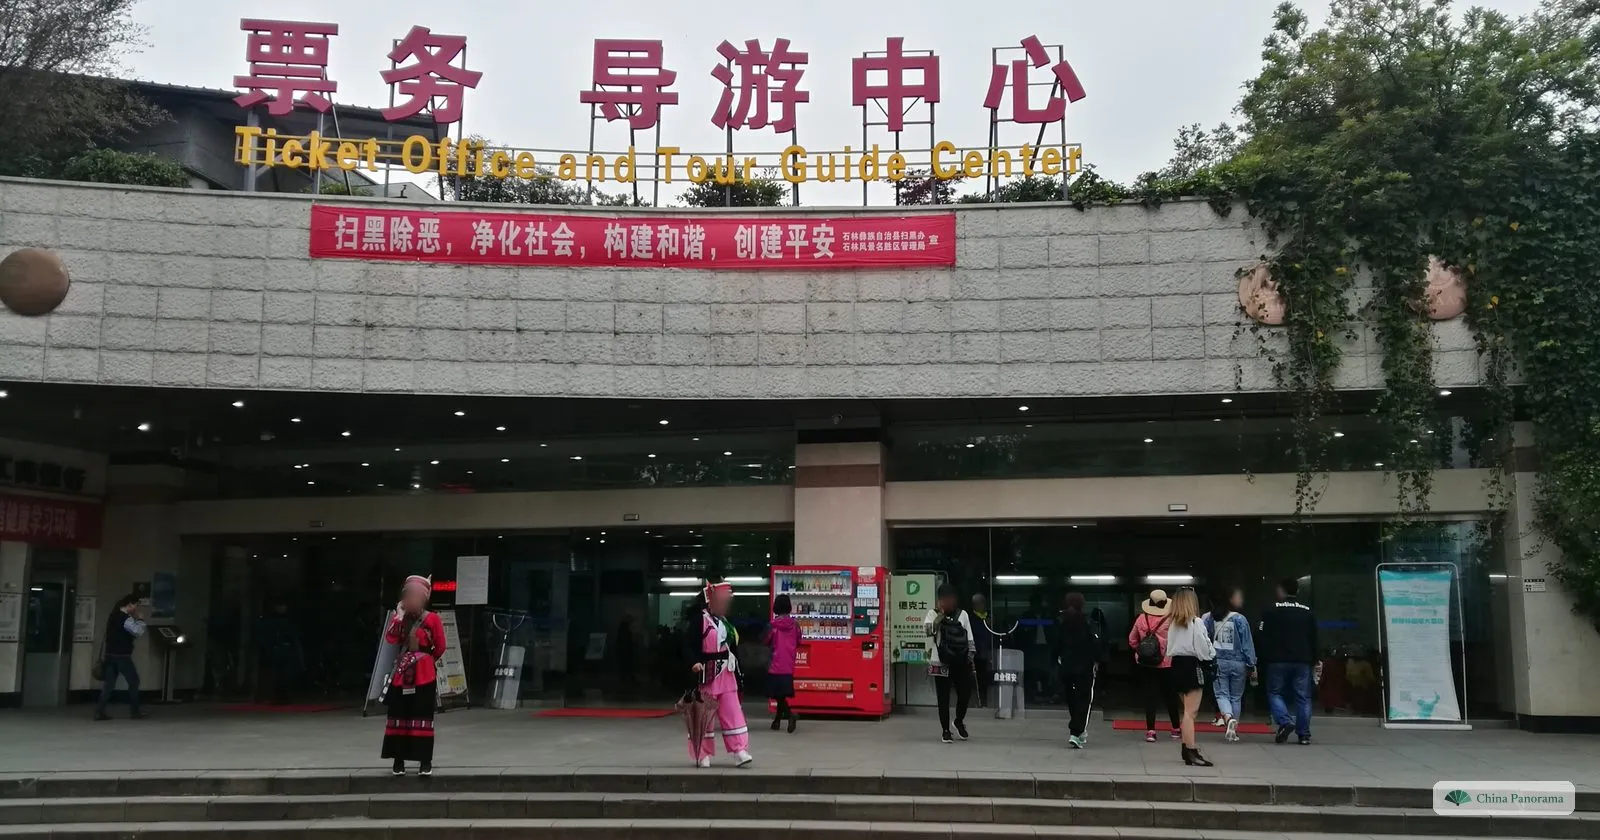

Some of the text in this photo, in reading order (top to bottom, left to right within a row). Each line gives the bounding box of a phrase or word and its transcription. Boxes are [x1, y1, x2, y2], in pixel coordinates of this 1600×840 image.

[233, 18, 1086, 133] 票务 导游中心
[235, 126, 1081, 184] Ticket Office and Tour Guide Center
[842, 231, 925, 241] 石林彝族自治县扫黑办
[842, 242, 925, 252] 石林风景名胜区管理局
[899, 601, 927, 610] 德克士
